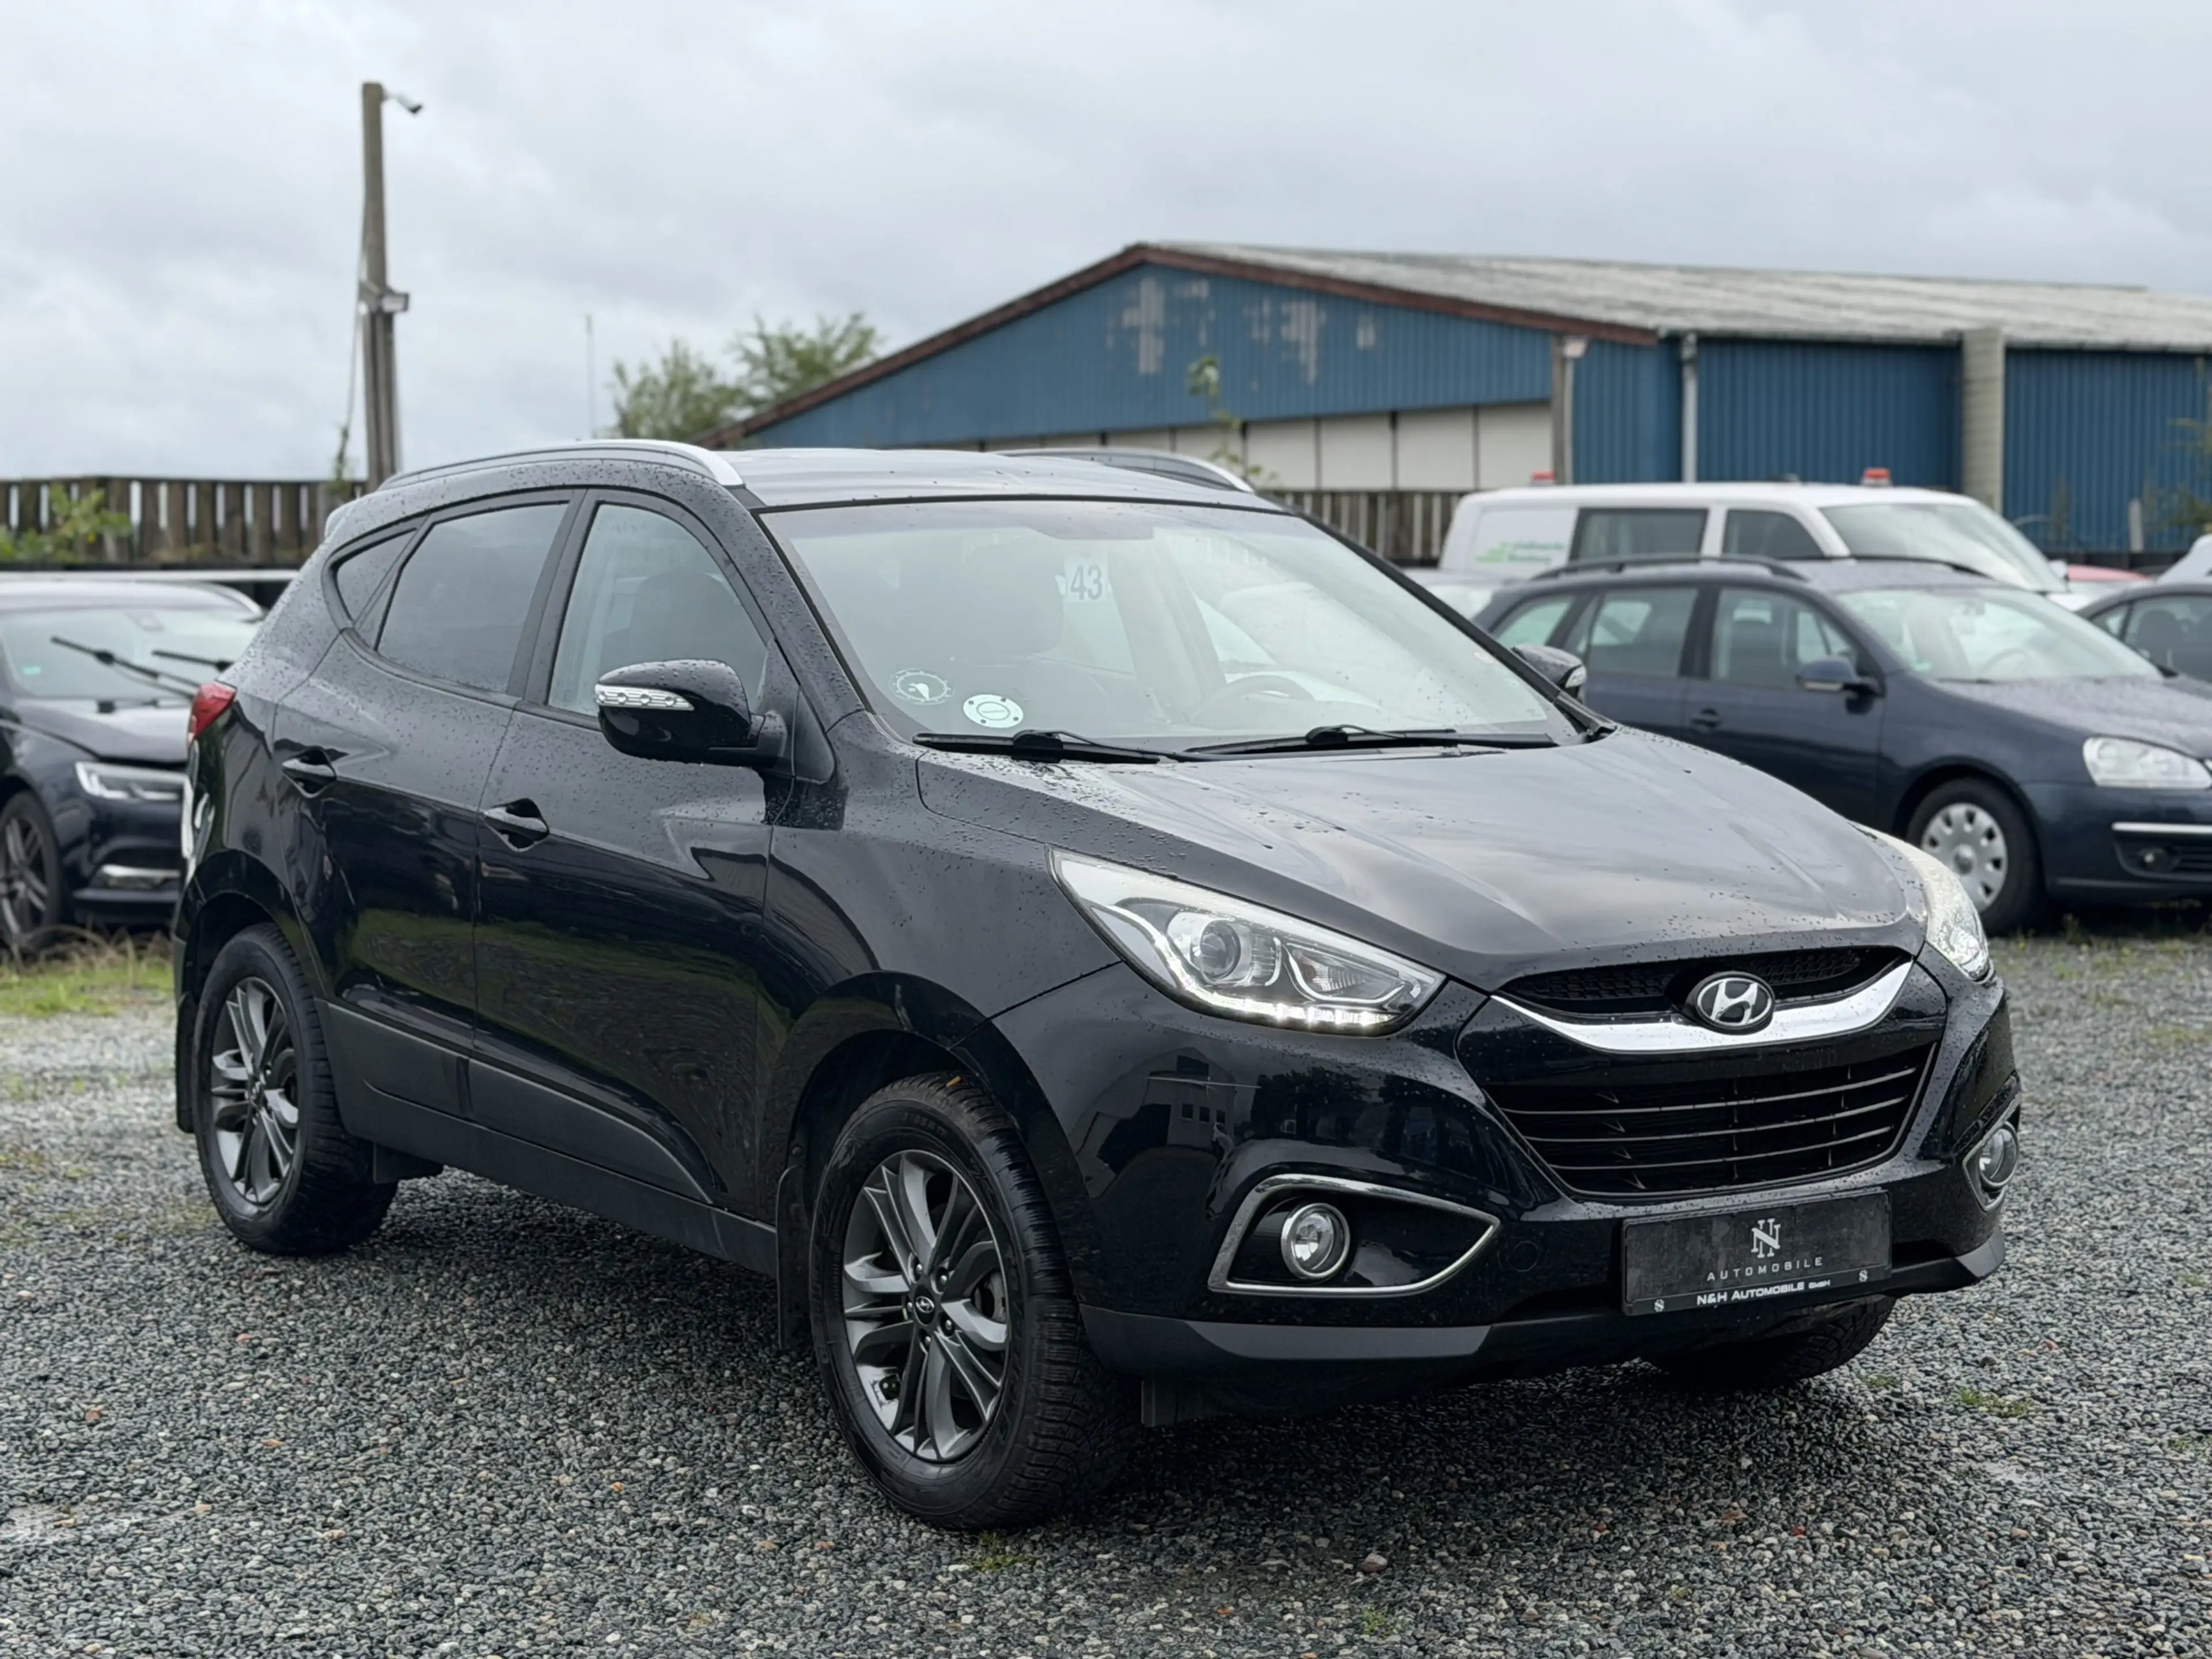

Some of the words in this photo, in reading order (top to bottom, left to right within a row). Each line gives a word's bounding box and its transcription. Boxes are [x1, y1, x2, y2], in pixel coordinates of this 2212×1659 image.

[1070, 565, 1103, 600] 43
[1706, 1257, 1823, 1282] AUTOMOBILE
[1697, 1291, 1727, 1306] N&H
[1731, 1281, 1805, 1301] AUTOMOBILE
